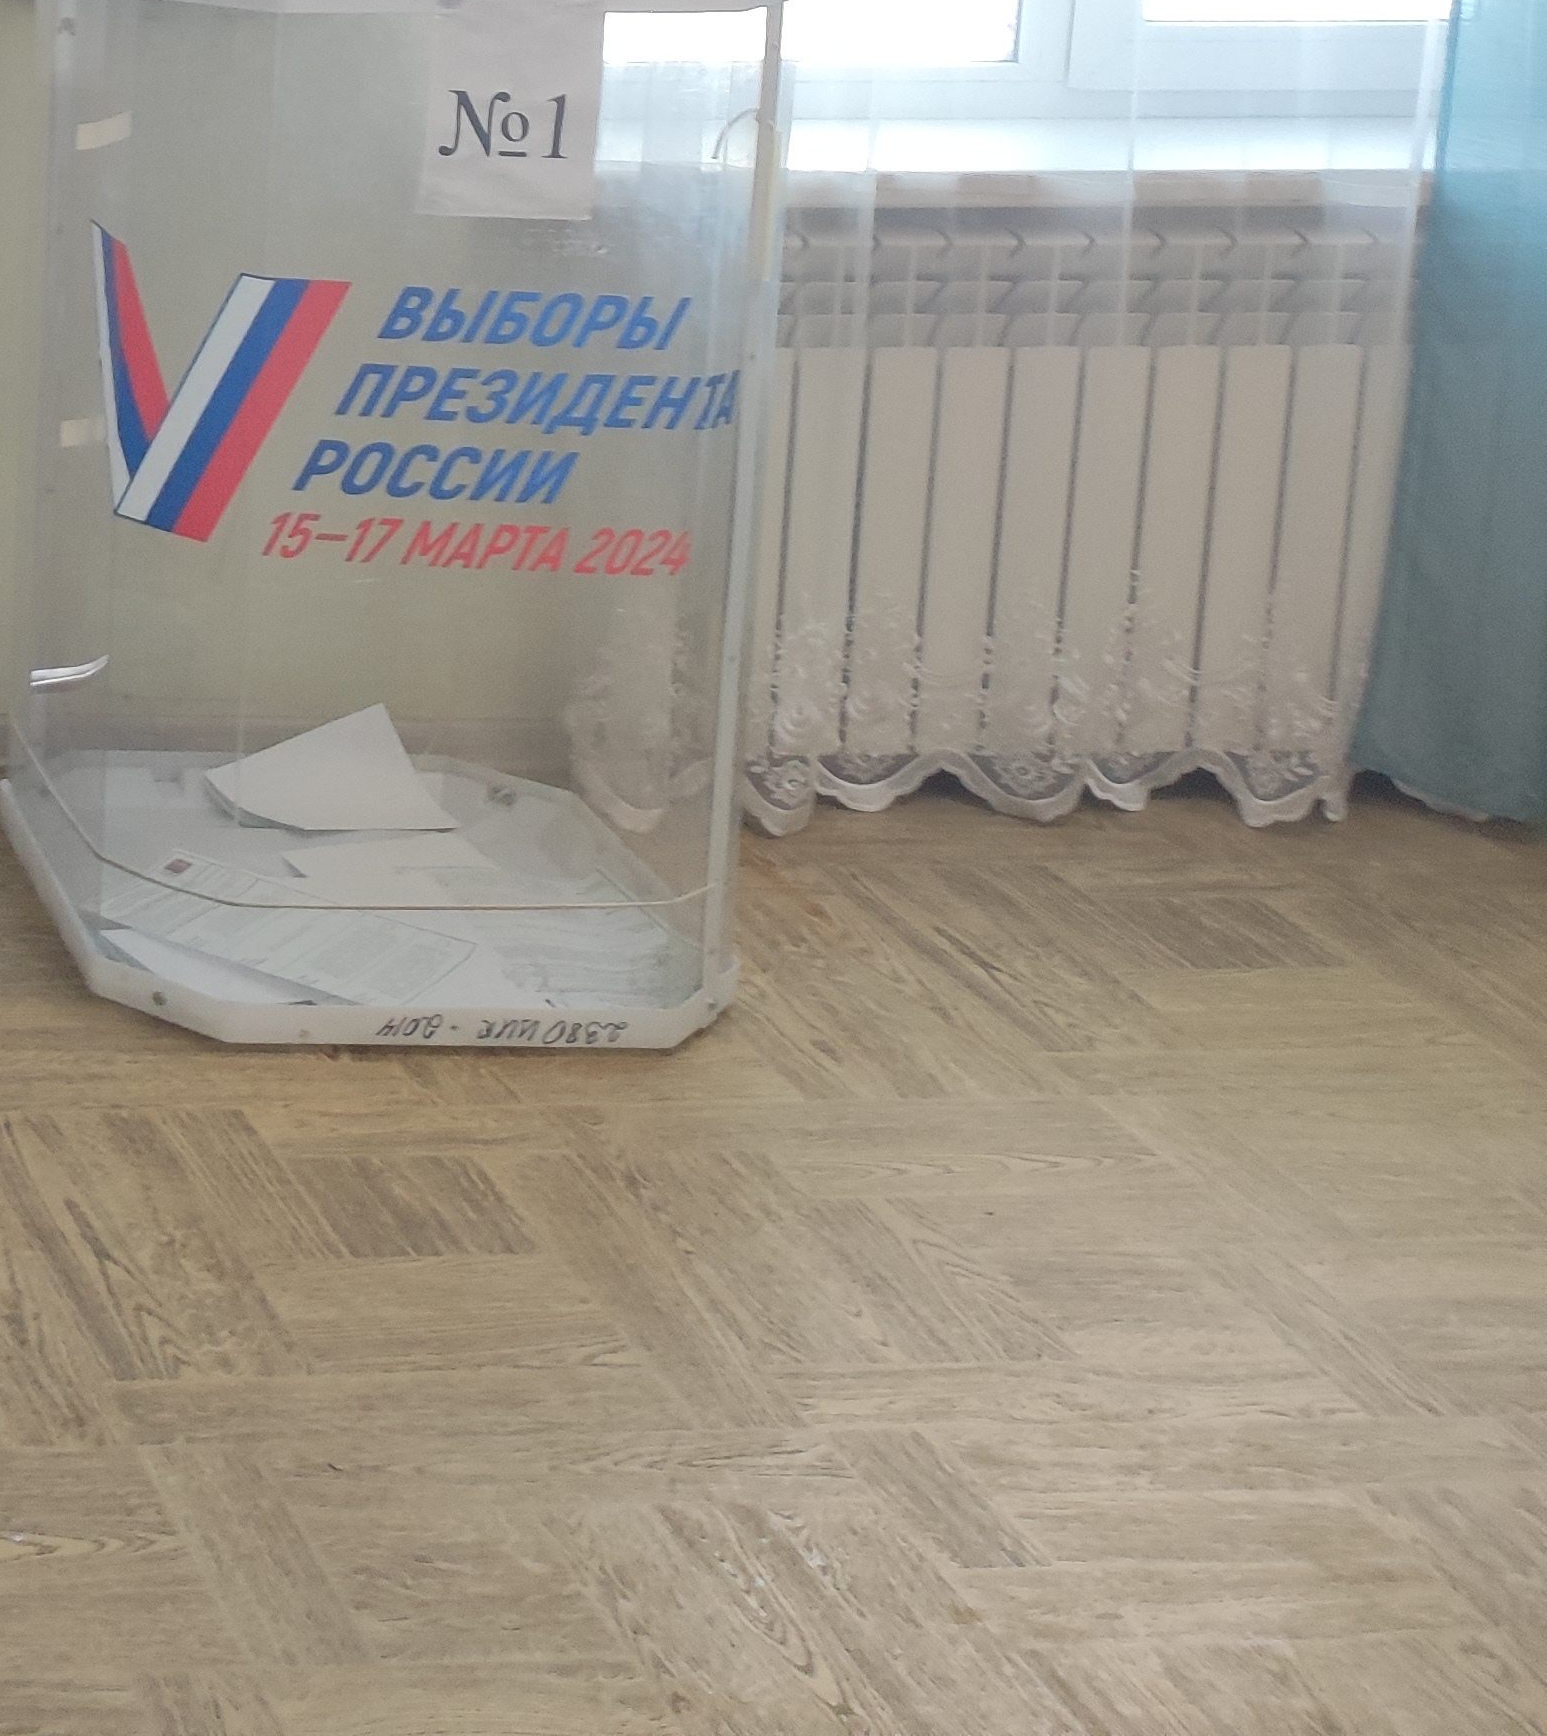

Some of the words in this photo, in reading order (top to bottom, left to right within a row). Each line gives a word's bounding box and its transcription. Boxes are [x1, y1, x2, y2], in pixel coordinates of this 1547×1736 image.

[377, 285, 692, 351] ВЫБОРЫ
[335, 363, 741, 435] ПРЕЗИДЕНТА
[292, 439, 581, 504] РОССИИ
[400, 521, 572, 572] МАРТА
[573, 528, 694, 576] 2024
